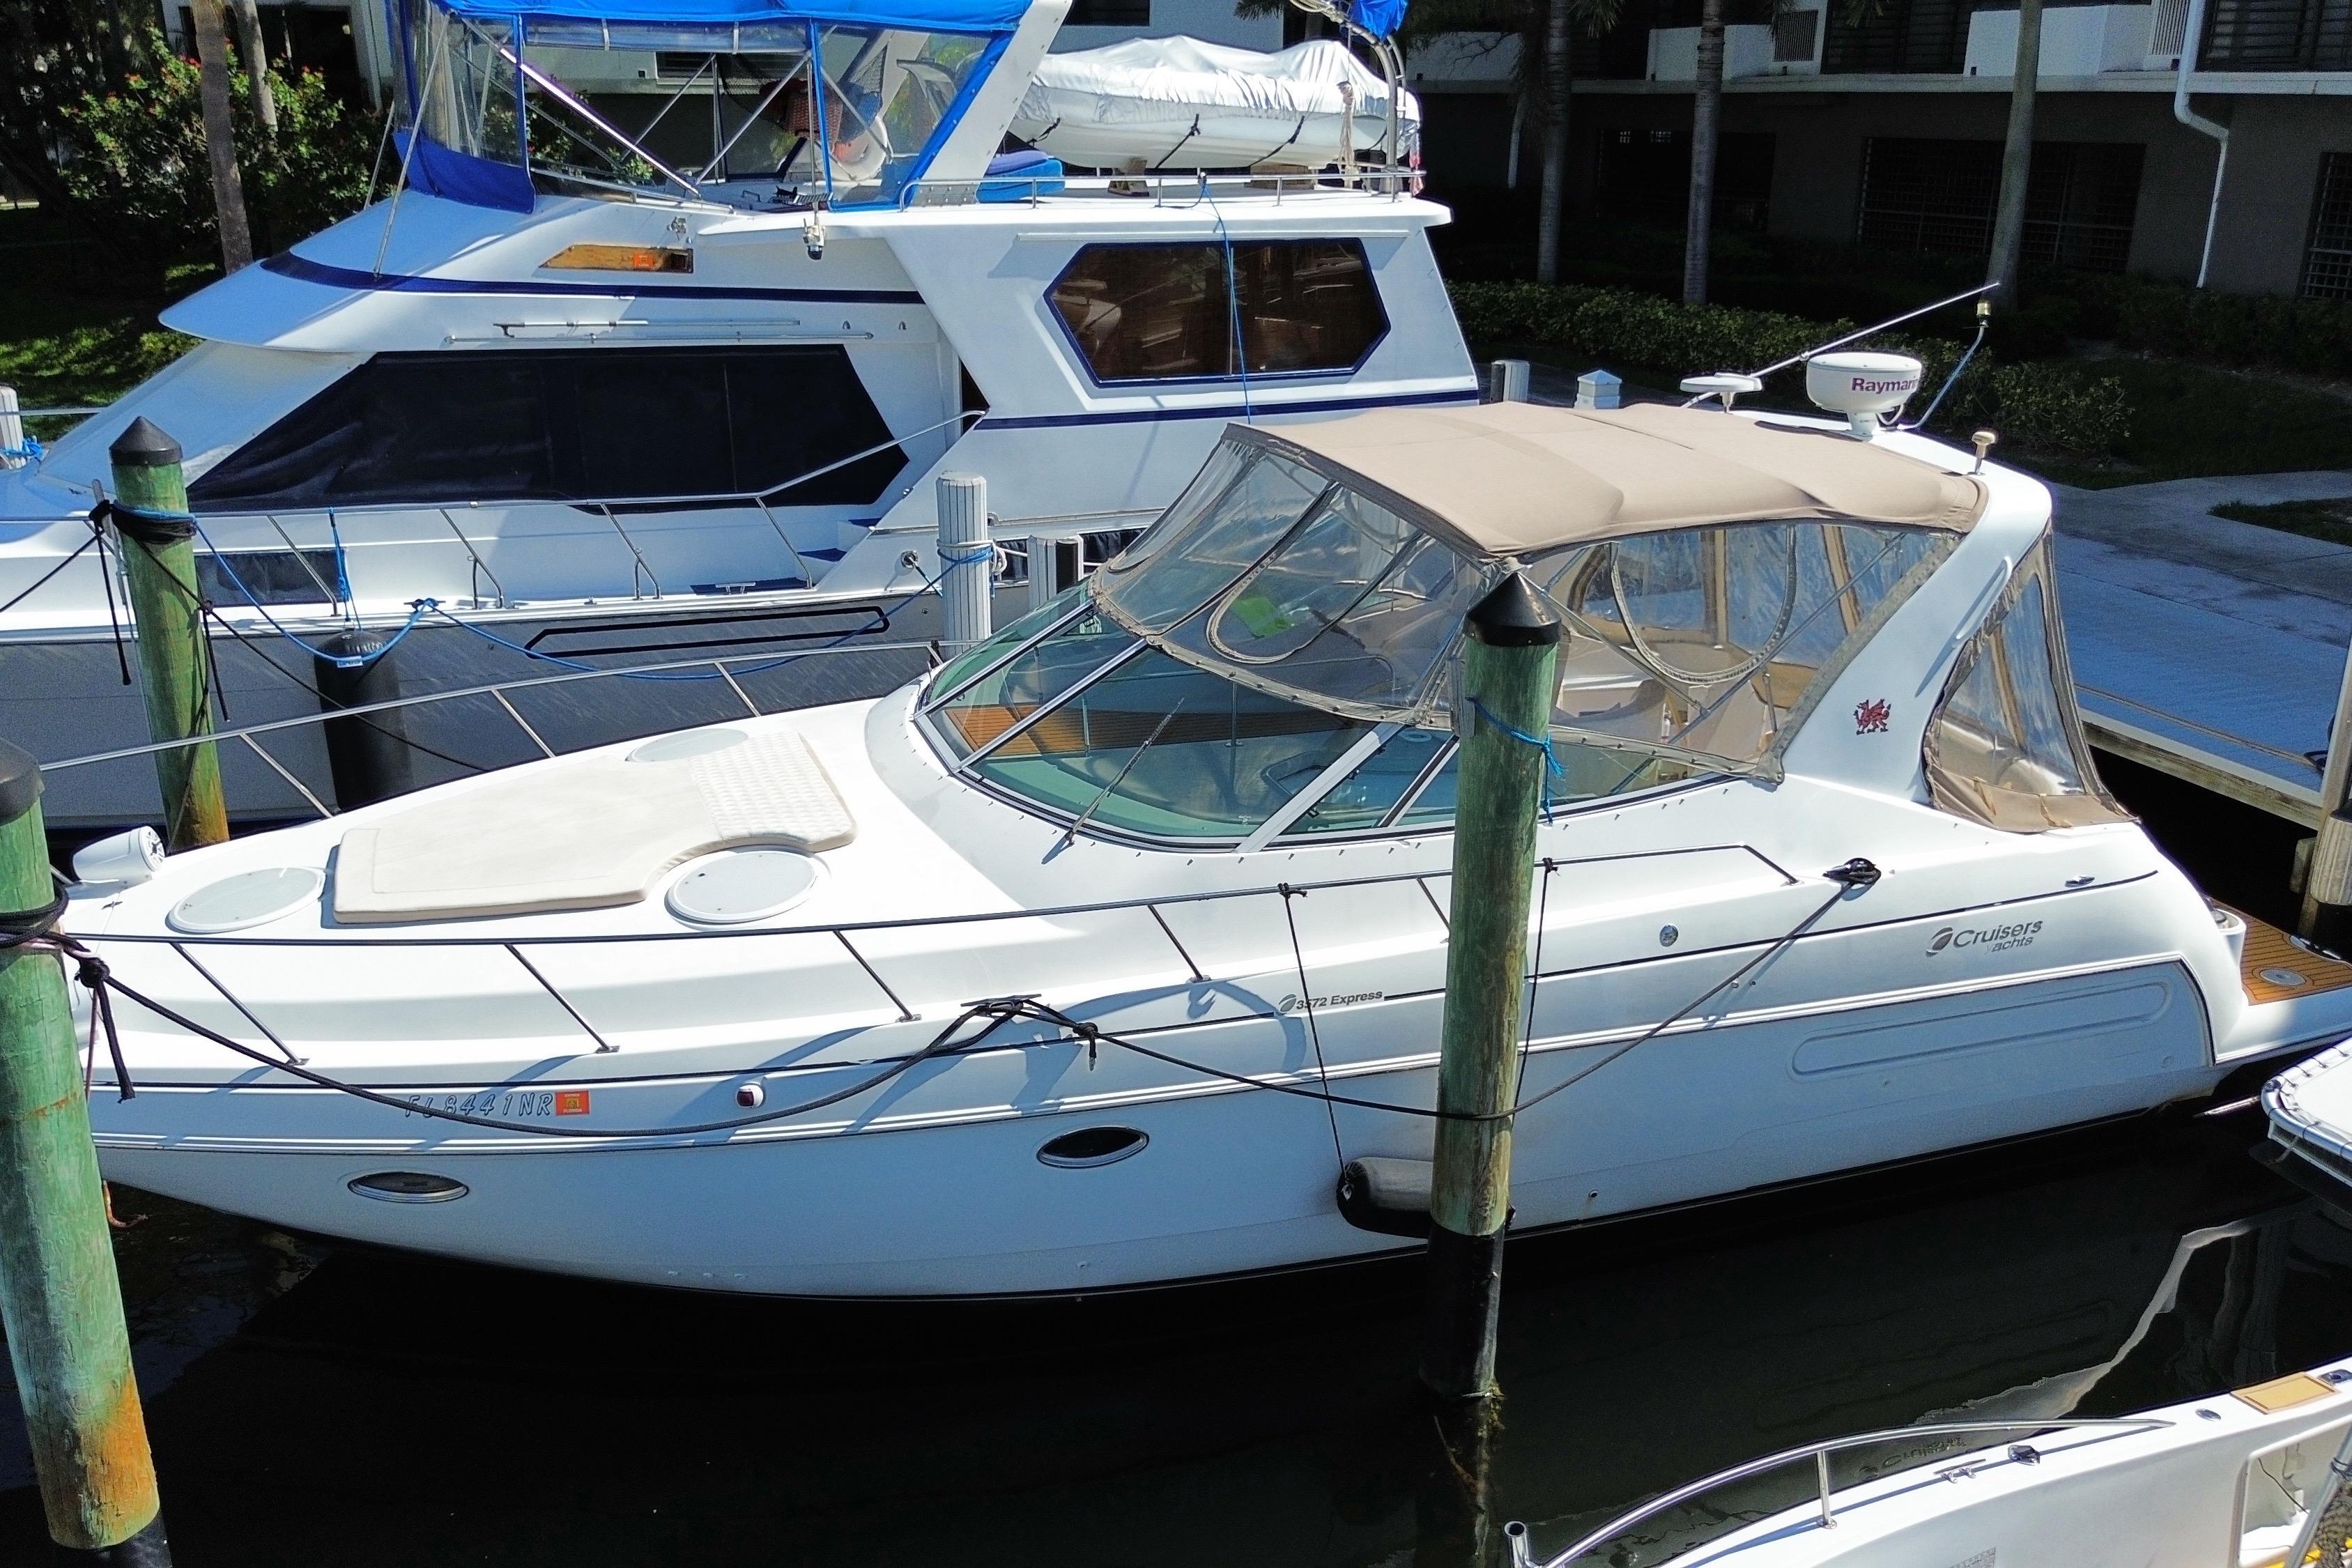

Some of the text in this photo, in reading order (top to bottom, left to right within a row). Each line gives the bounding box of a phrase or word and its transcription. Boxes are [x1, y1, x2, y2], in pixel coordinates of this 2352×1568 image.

[1953, 920, 2043, 948] Cruisers
[1296, 990, 1383, 1010] 3572 Express
